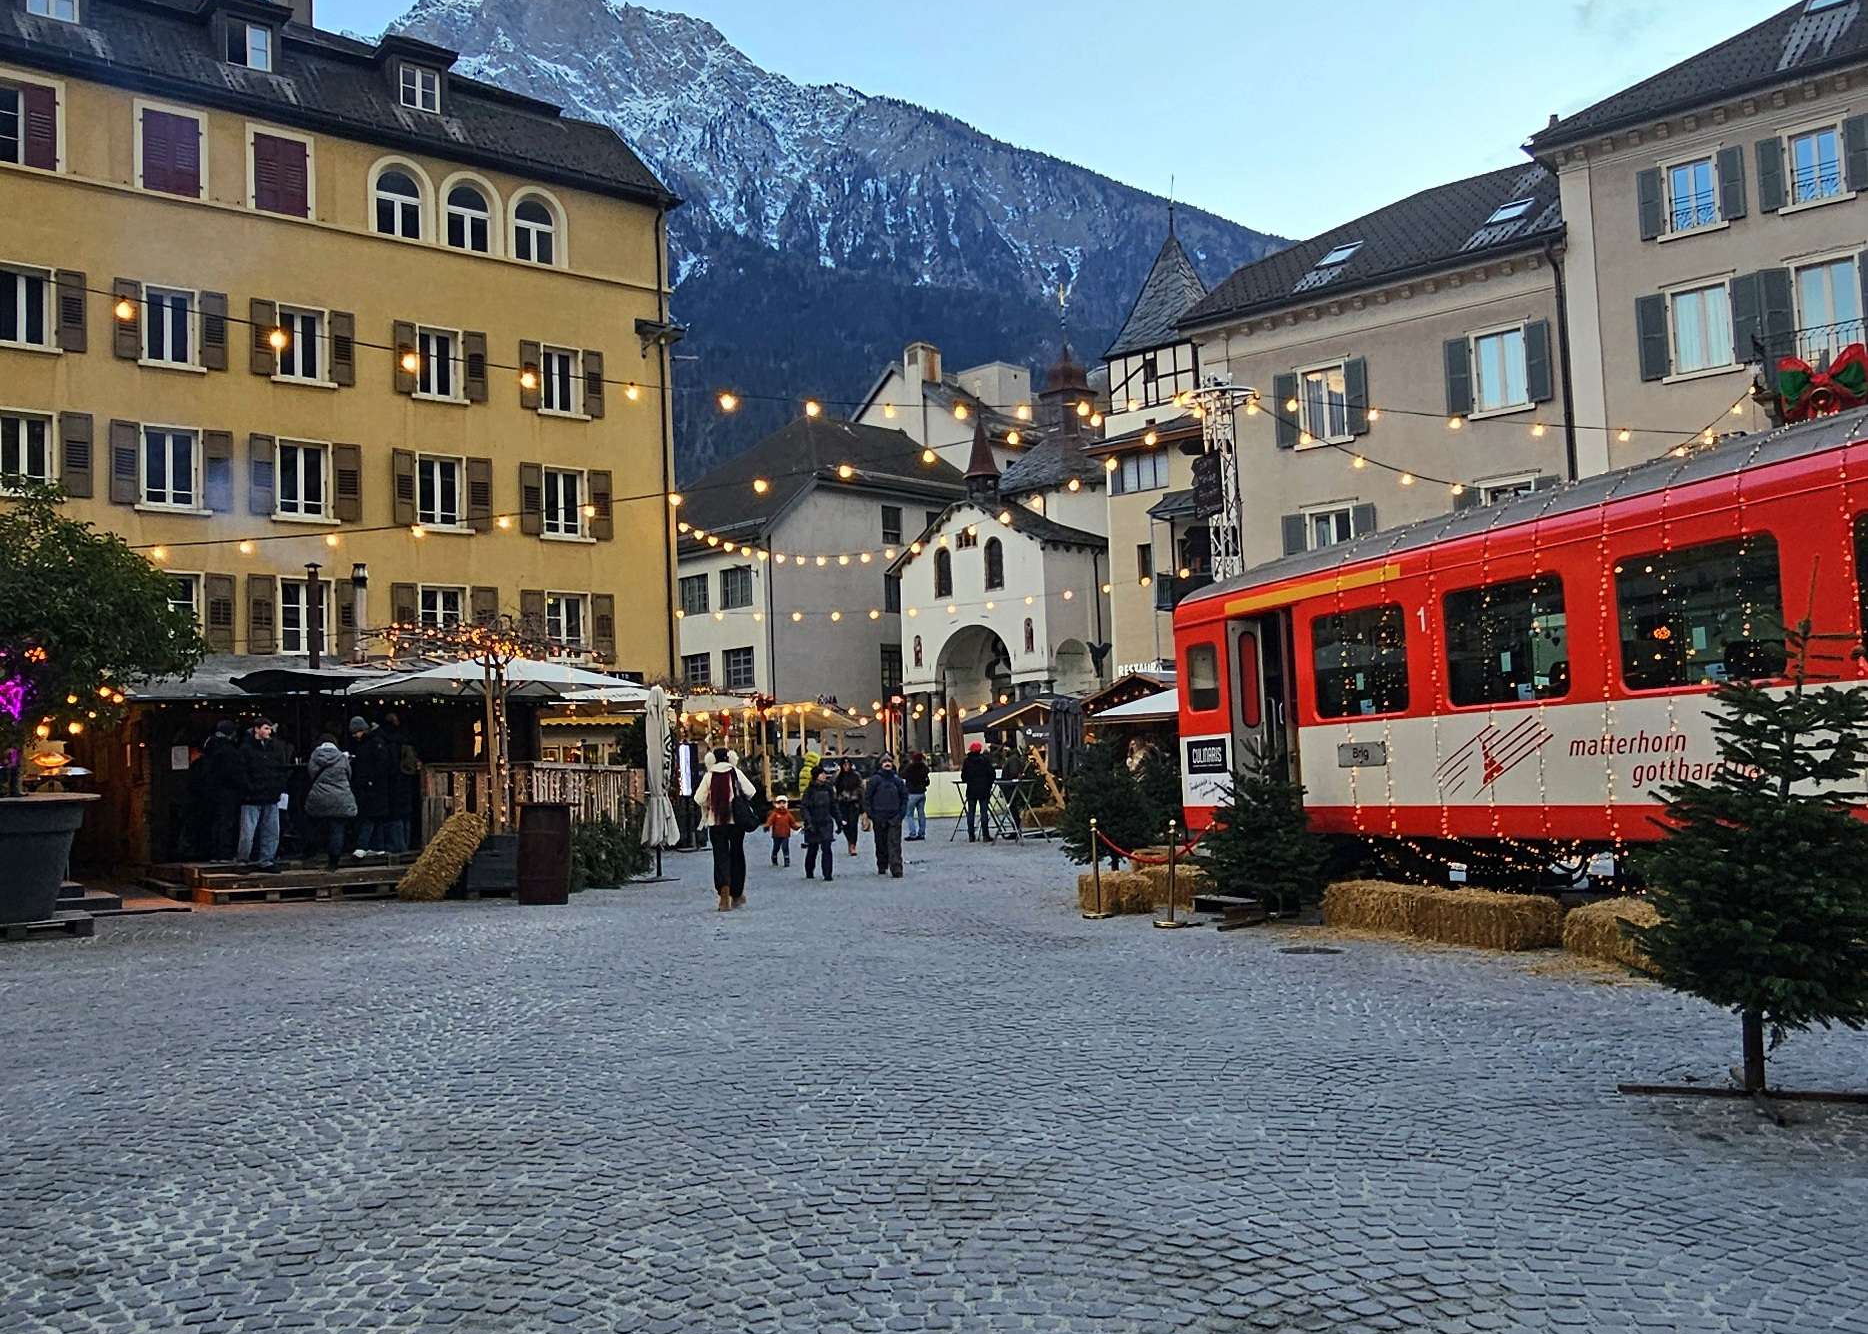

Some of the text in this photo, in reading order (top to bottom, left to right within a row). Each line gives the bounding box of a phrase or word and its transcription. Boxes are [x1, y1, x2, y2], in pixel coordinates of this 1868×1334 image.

[1416, 606, 1426, 633] 1
[1118, 661, 1163, 678] RESTAURA
[1569, 730, 1686, 756] matterhorn
[1192, 747, 1222, 764] CULINARIS
[1352, 747, 1370, 761] Brig
